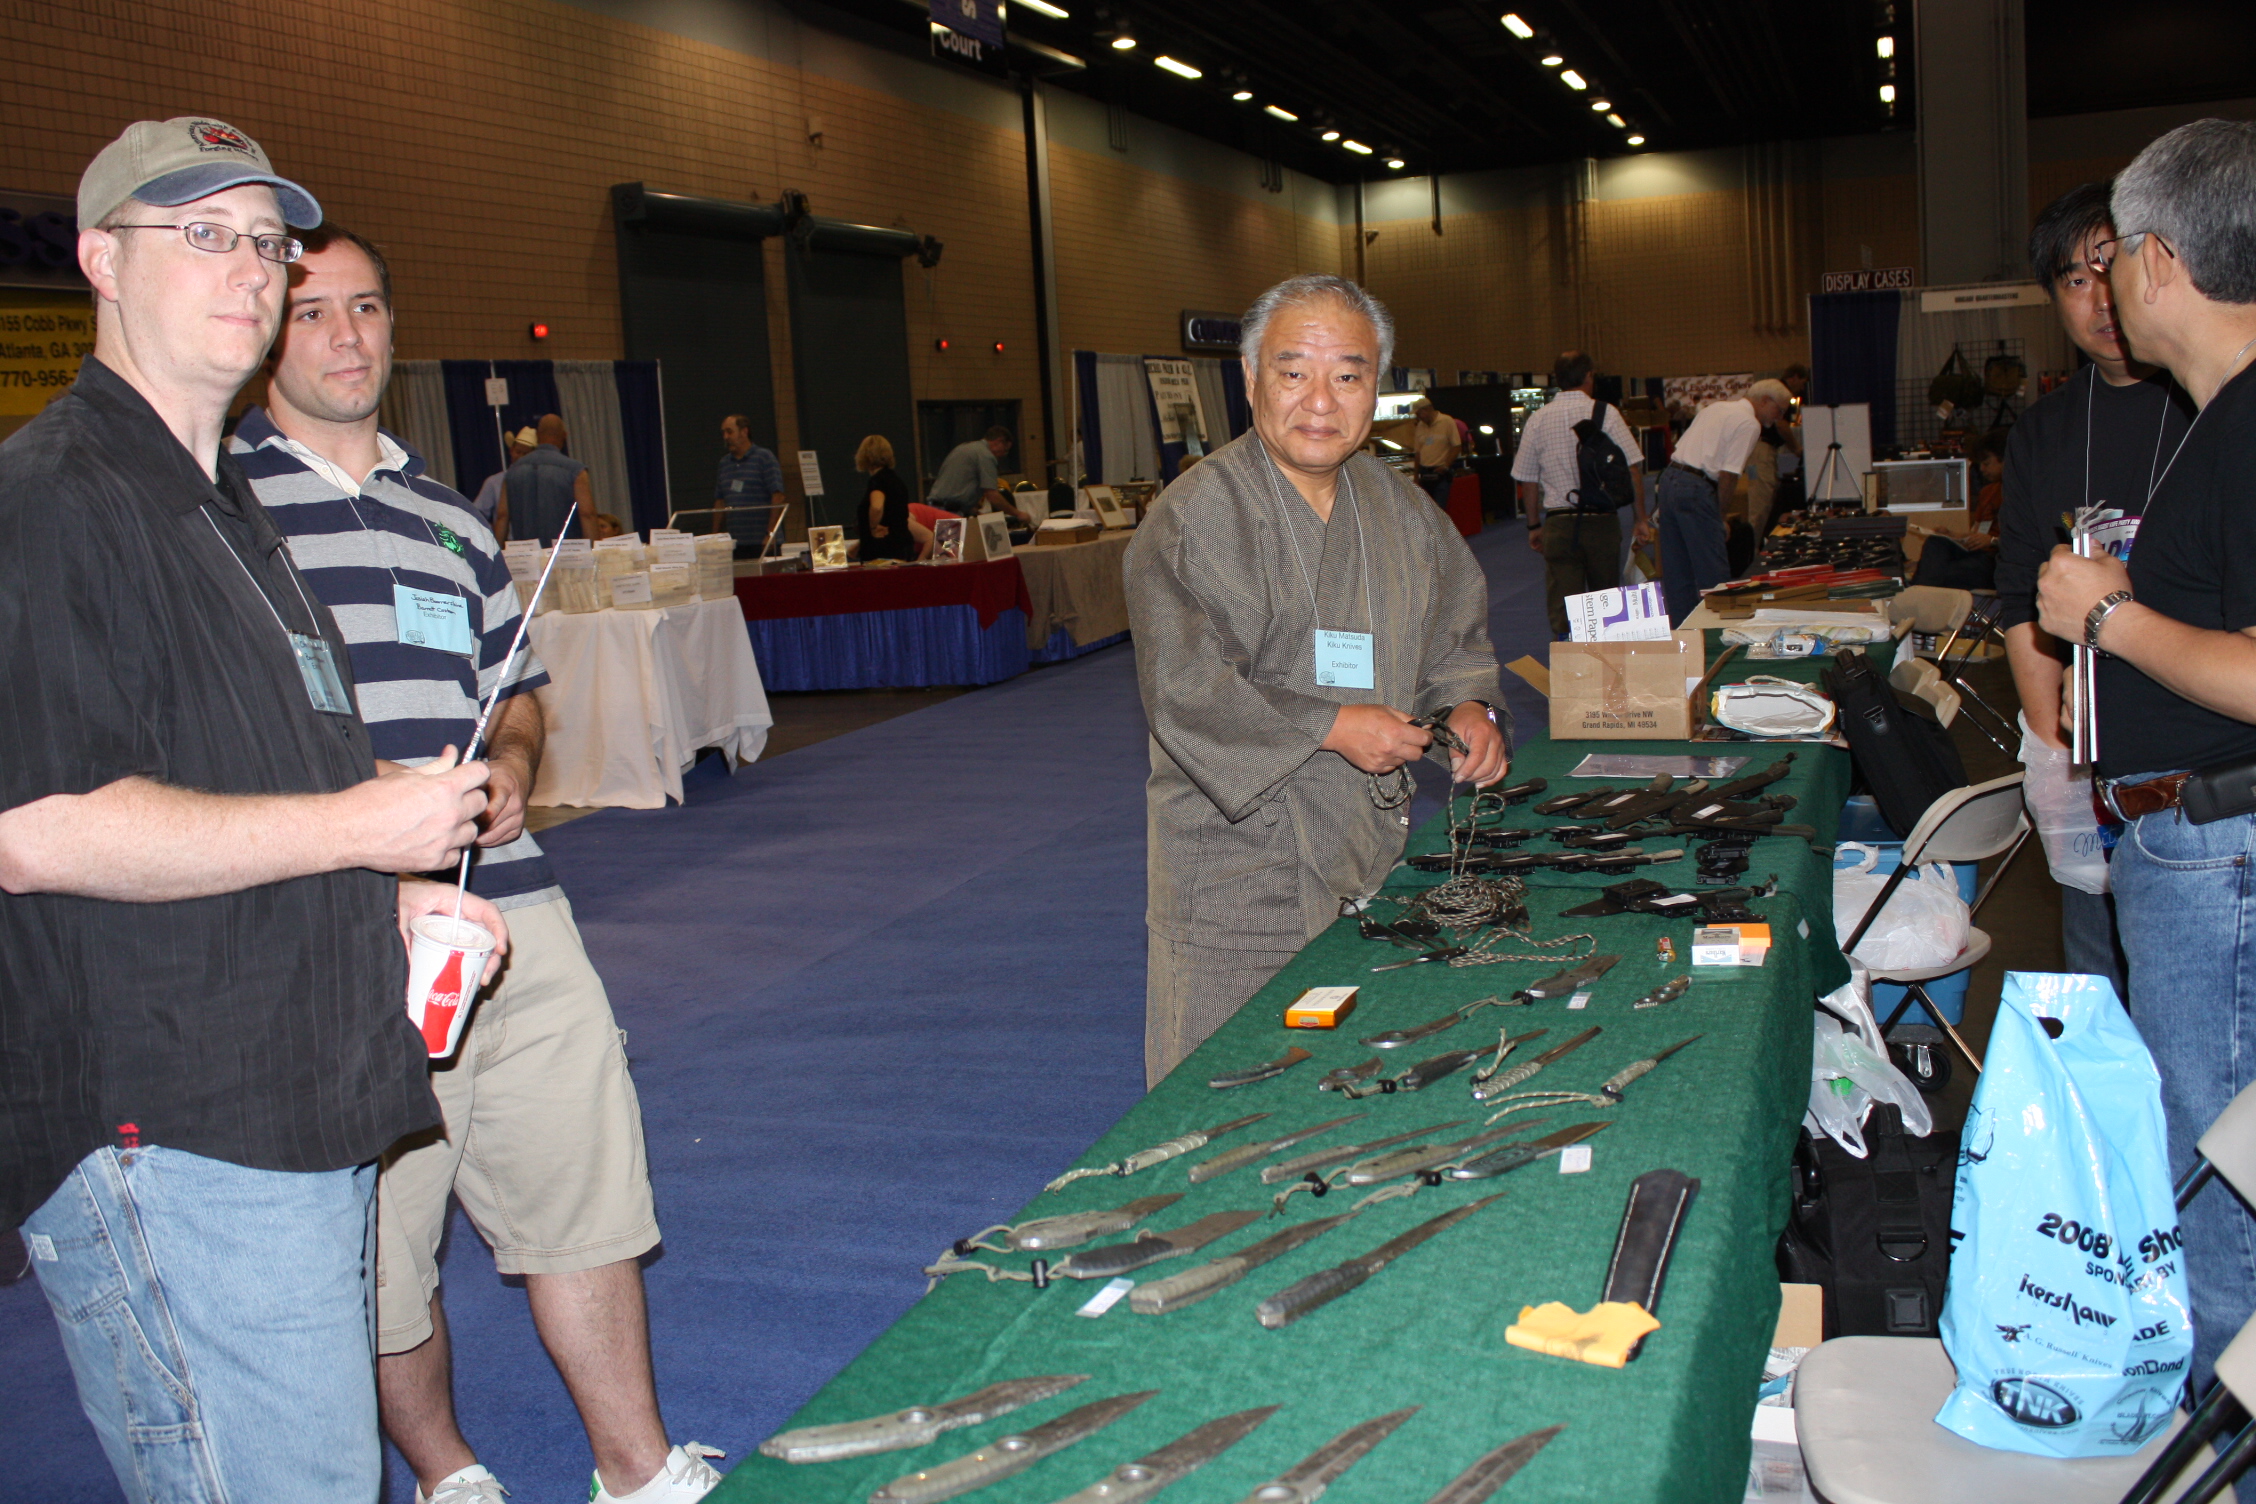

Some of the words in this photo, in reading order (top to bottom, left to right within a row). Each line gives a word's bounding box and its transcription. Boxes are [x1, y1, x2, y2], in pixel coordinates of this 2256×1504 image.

[940, 30, 982, 61] Court
[1826, 272, 1870, 292] DISPLAY
[1875, 269, 1910, 288] CASES
[24, 315, 55, 332] Cobb
[58, 315, 88, 336] Pkwy
[0, 342, 47, 360] Atlanta,
[50, 342, 71, 359] GA
[0, 370, 80, 388] 770-956-
[1600, 593, 1609, 610] ge.
[1324, 631, 1338, 639] Kiku
[1339, 633, 1366, 641] Matsuda
[1327, 641, 1341, 649] Kiku
[1342, 642, 1363, 651] Knives
[1331, 660, 1358, 669] Exhibitor
[1602, 721, 1625, 729] Rapids,
[2036, 1212, 2113, 1259] 2008
[2155, 1260, 2177, 1280] BY
[2018, 1273, 2118, 1328] kershaw
[2046, 1341, 2079, 1358] Russell
[2081, 1353, 2113, 1370] Knives
[1994, 1367, 2015, 1376] TRUE
[2053, 1380, 2086, 1406] KNIVES
[2001, 1381, 2069, 1424] TNK
